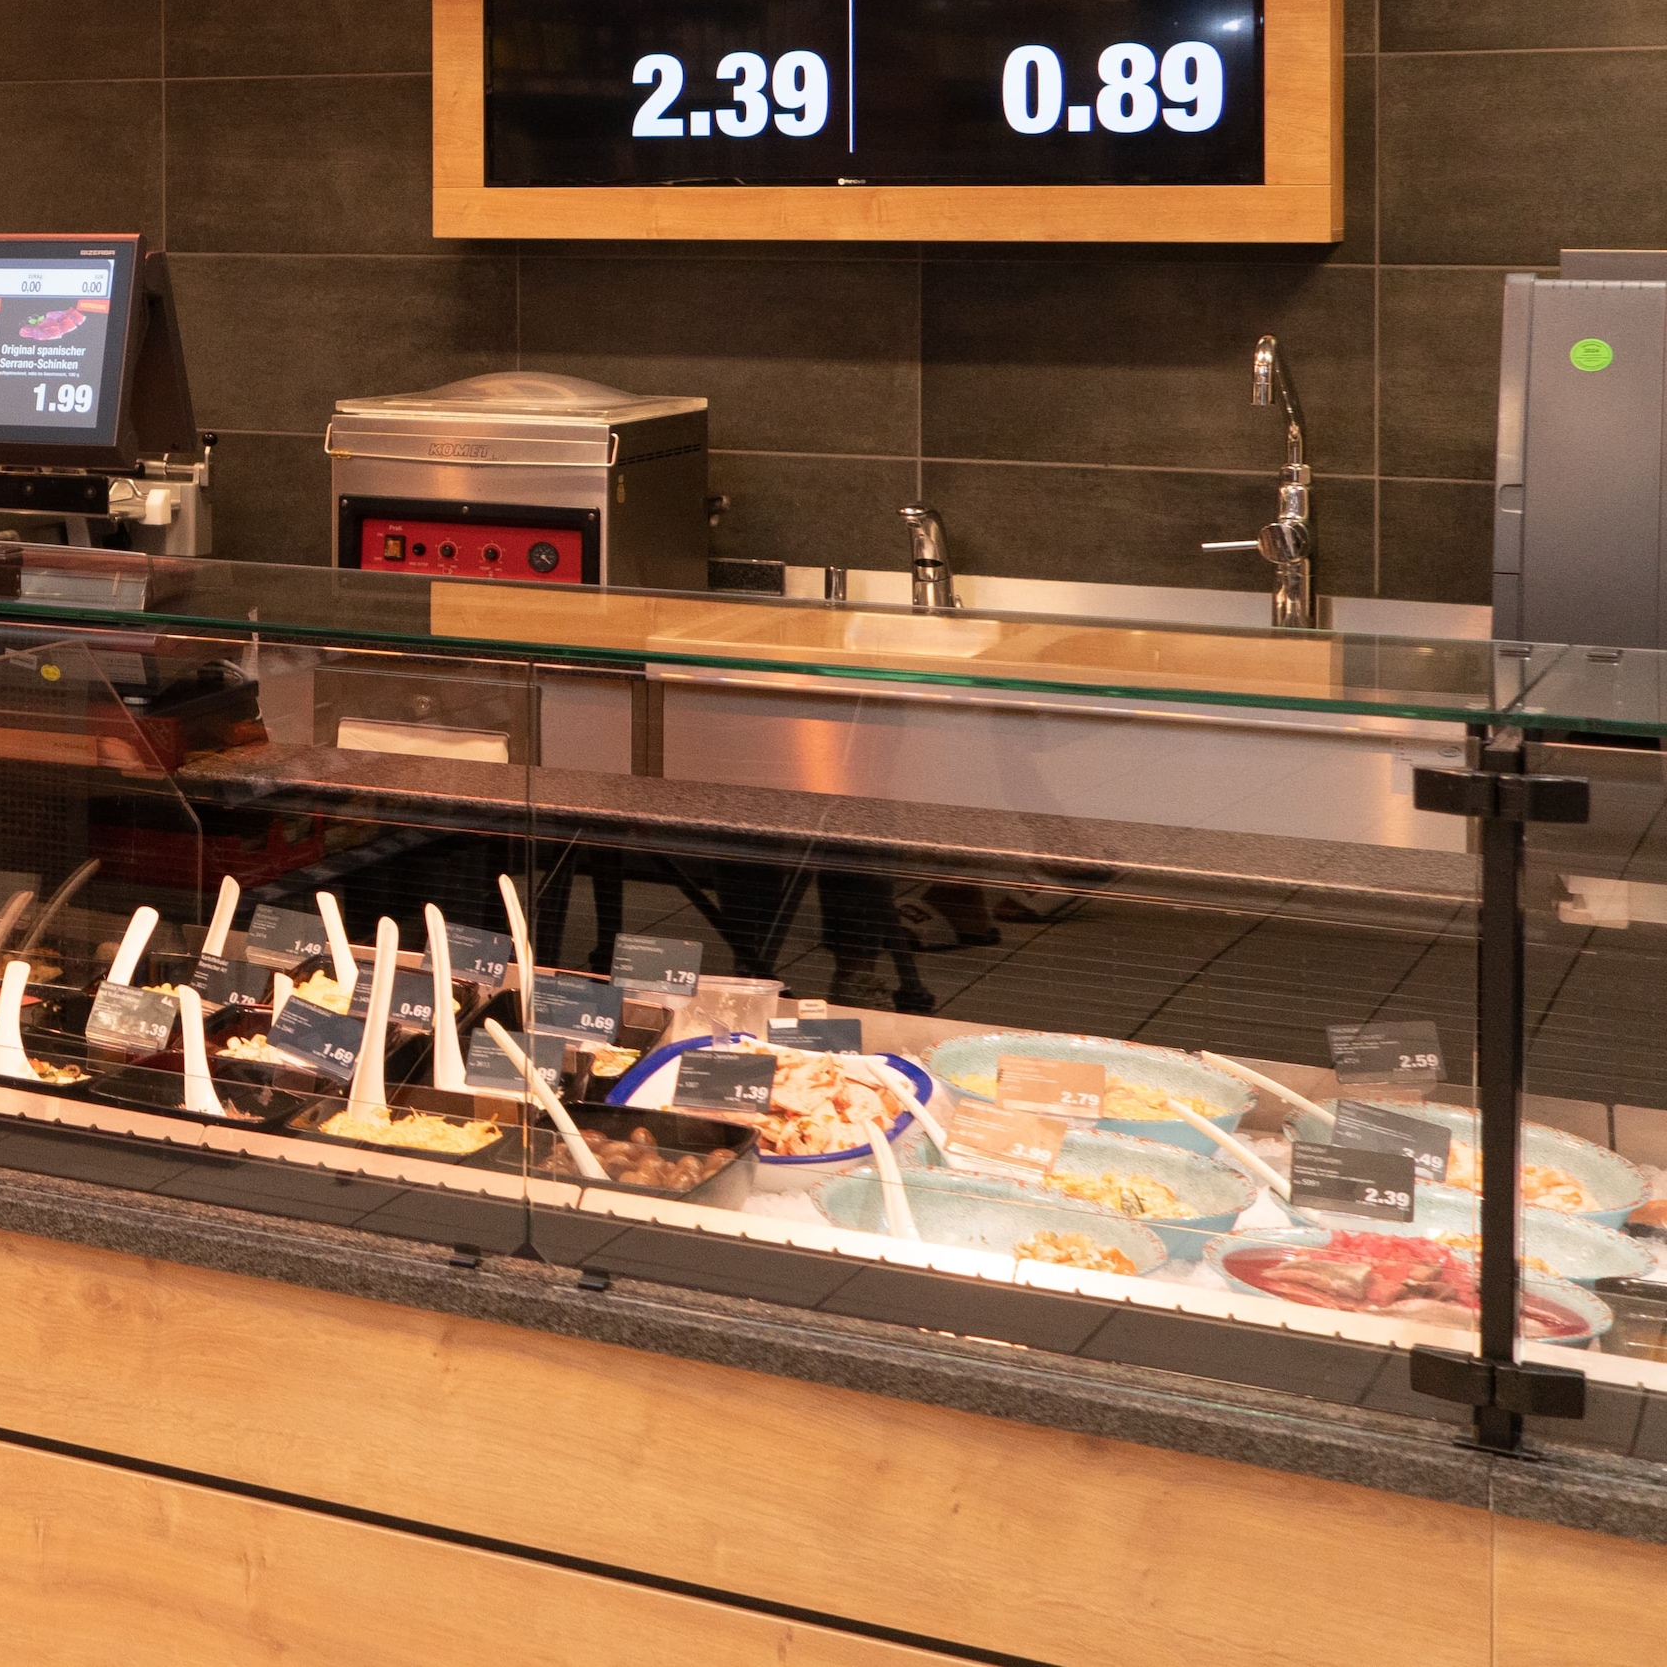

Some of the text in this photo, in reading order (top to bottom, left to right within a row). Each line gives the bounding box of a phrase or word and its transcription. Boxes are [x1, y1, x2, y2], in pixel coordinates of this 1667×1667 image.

[631, 50, 830, 138] 2.39
[1002, 40, 1224, 134] 0.89
[21, 281, 41, 293] 0,00
[82, 281, 102, 294] 0,00
[1, 344, 86, 358] Original spanischer
[0, 357, 78, 370] Serrano-Schinken
[33, 383, 93, 413] 1.99
[428, 443, 490, 458] KOMET
[293, 940, 322, 956] 1.49
[474, 958, 505, 975] 1.19
[665, 969, 697, 985] 1.79
[400, 1002, 432, 1018] 0.69
[138, 1020, 168, 1038] 1.39
[580, 1013, 615, 1031] 0.69
[322, 1042, 355, 1065] 1.69
[1398, 1053, 1440, 1069] 2.59
[734, 1084, 768, 1100] 1.39
[1060, 1090, 1101, 1106] 2.79
[1011, 1143, 1053, 1163] 3.99
[1401, 1147, 1445, 1169] 3.49
[1364, 1187, 1411, 1208] 2.39
